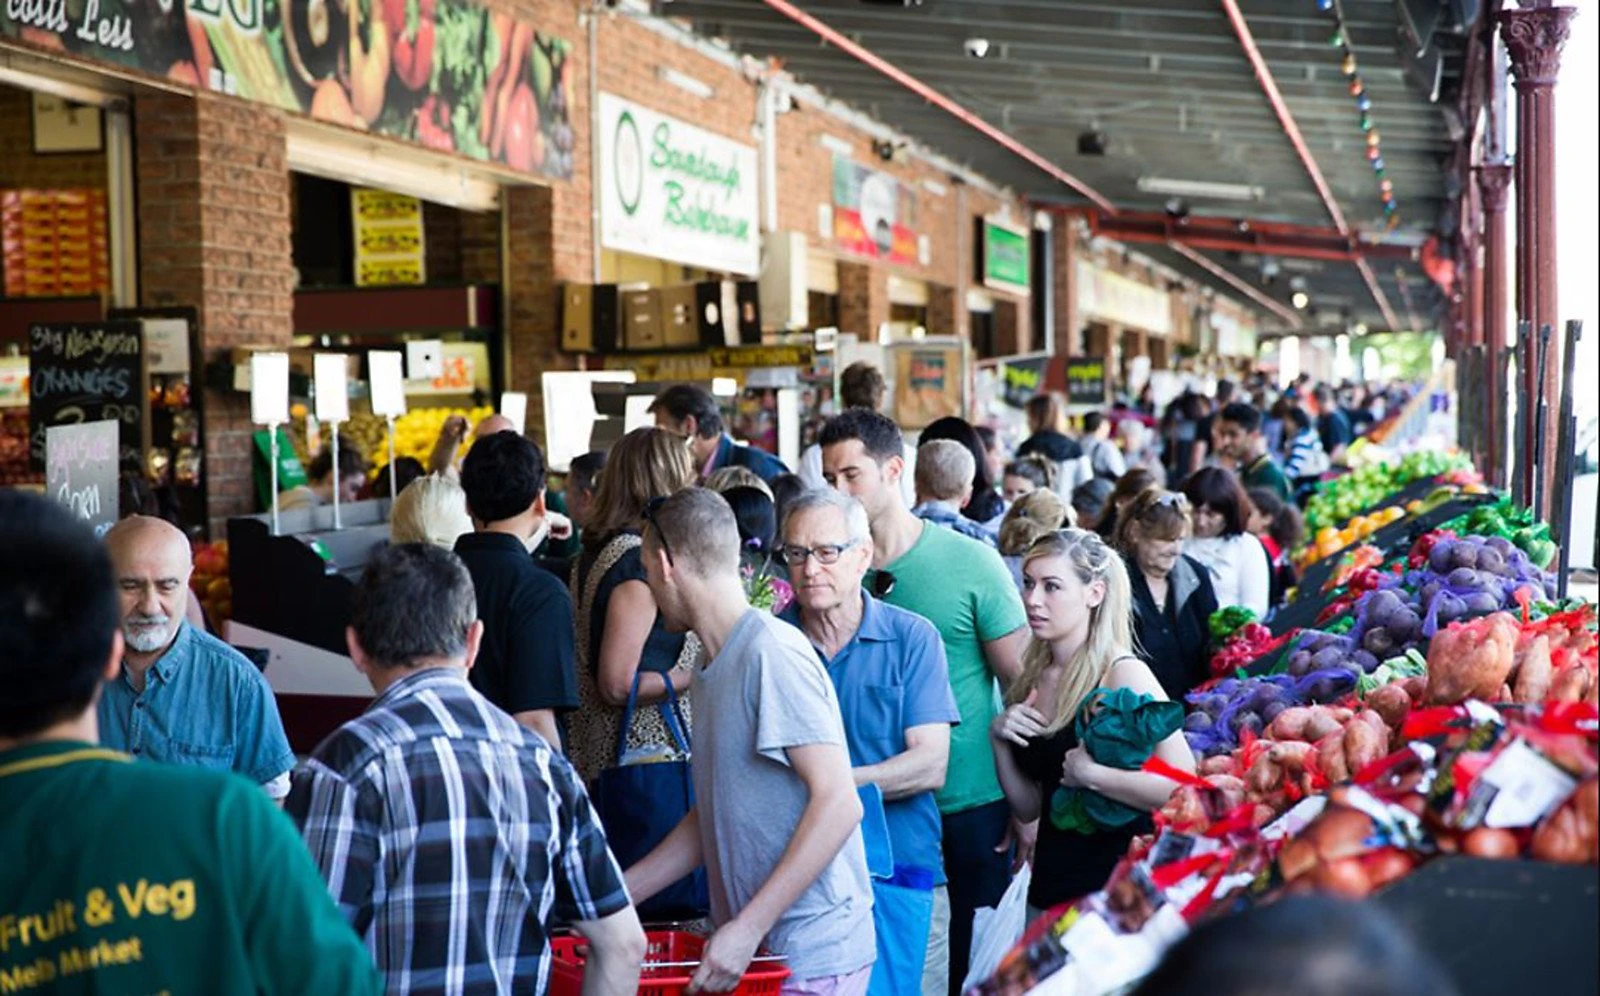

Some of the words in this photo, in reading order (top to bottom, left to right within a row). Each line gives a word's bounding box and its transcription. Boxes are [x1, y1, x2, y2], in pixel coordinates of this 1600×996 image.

[76, 0, 134, 51] Less
[0, 900, 77, 951] Fruit
[84, 887, 115, 928] &
[117, 876, 197, 922] Veg
